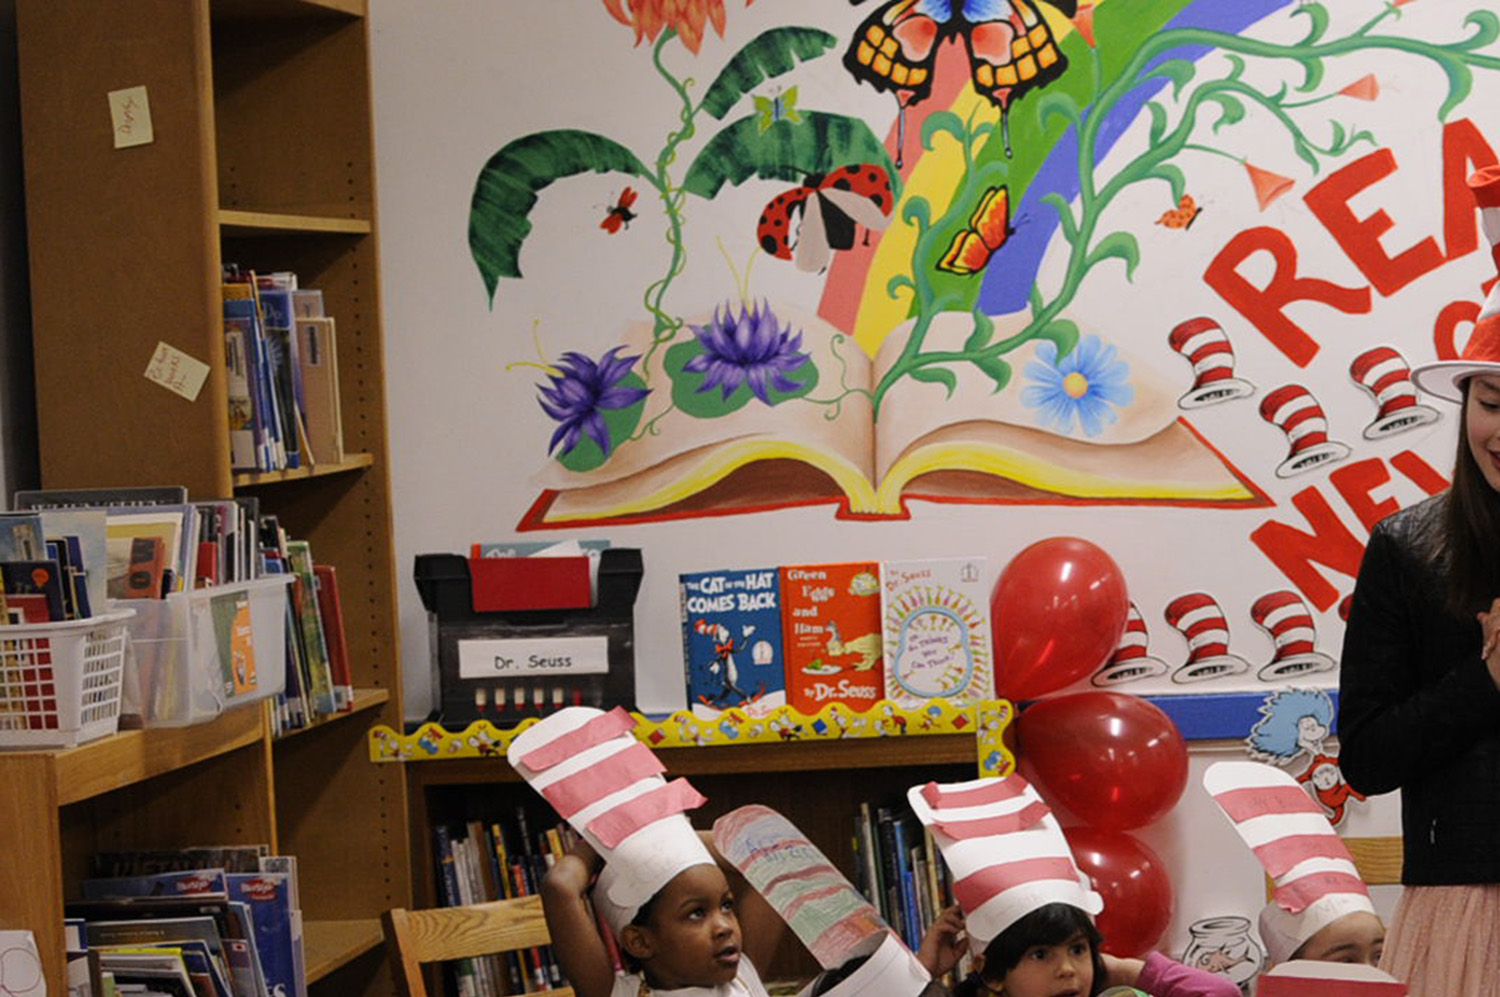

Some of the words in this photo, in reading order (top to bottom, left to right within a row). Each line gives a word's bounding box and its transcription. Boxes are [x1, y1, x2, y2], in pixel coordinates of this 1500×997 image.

[700, 577, 726, 594] CAT
[745, 572, 774, 590] HAT
[687, 594, 735, 613] COMES
[737, 592, 776, 611] BACK
[494, 656, 519, 670] Dr.
[528, 655, 572, 669] Seuss
[838, 679, 877, 699] Seuss
